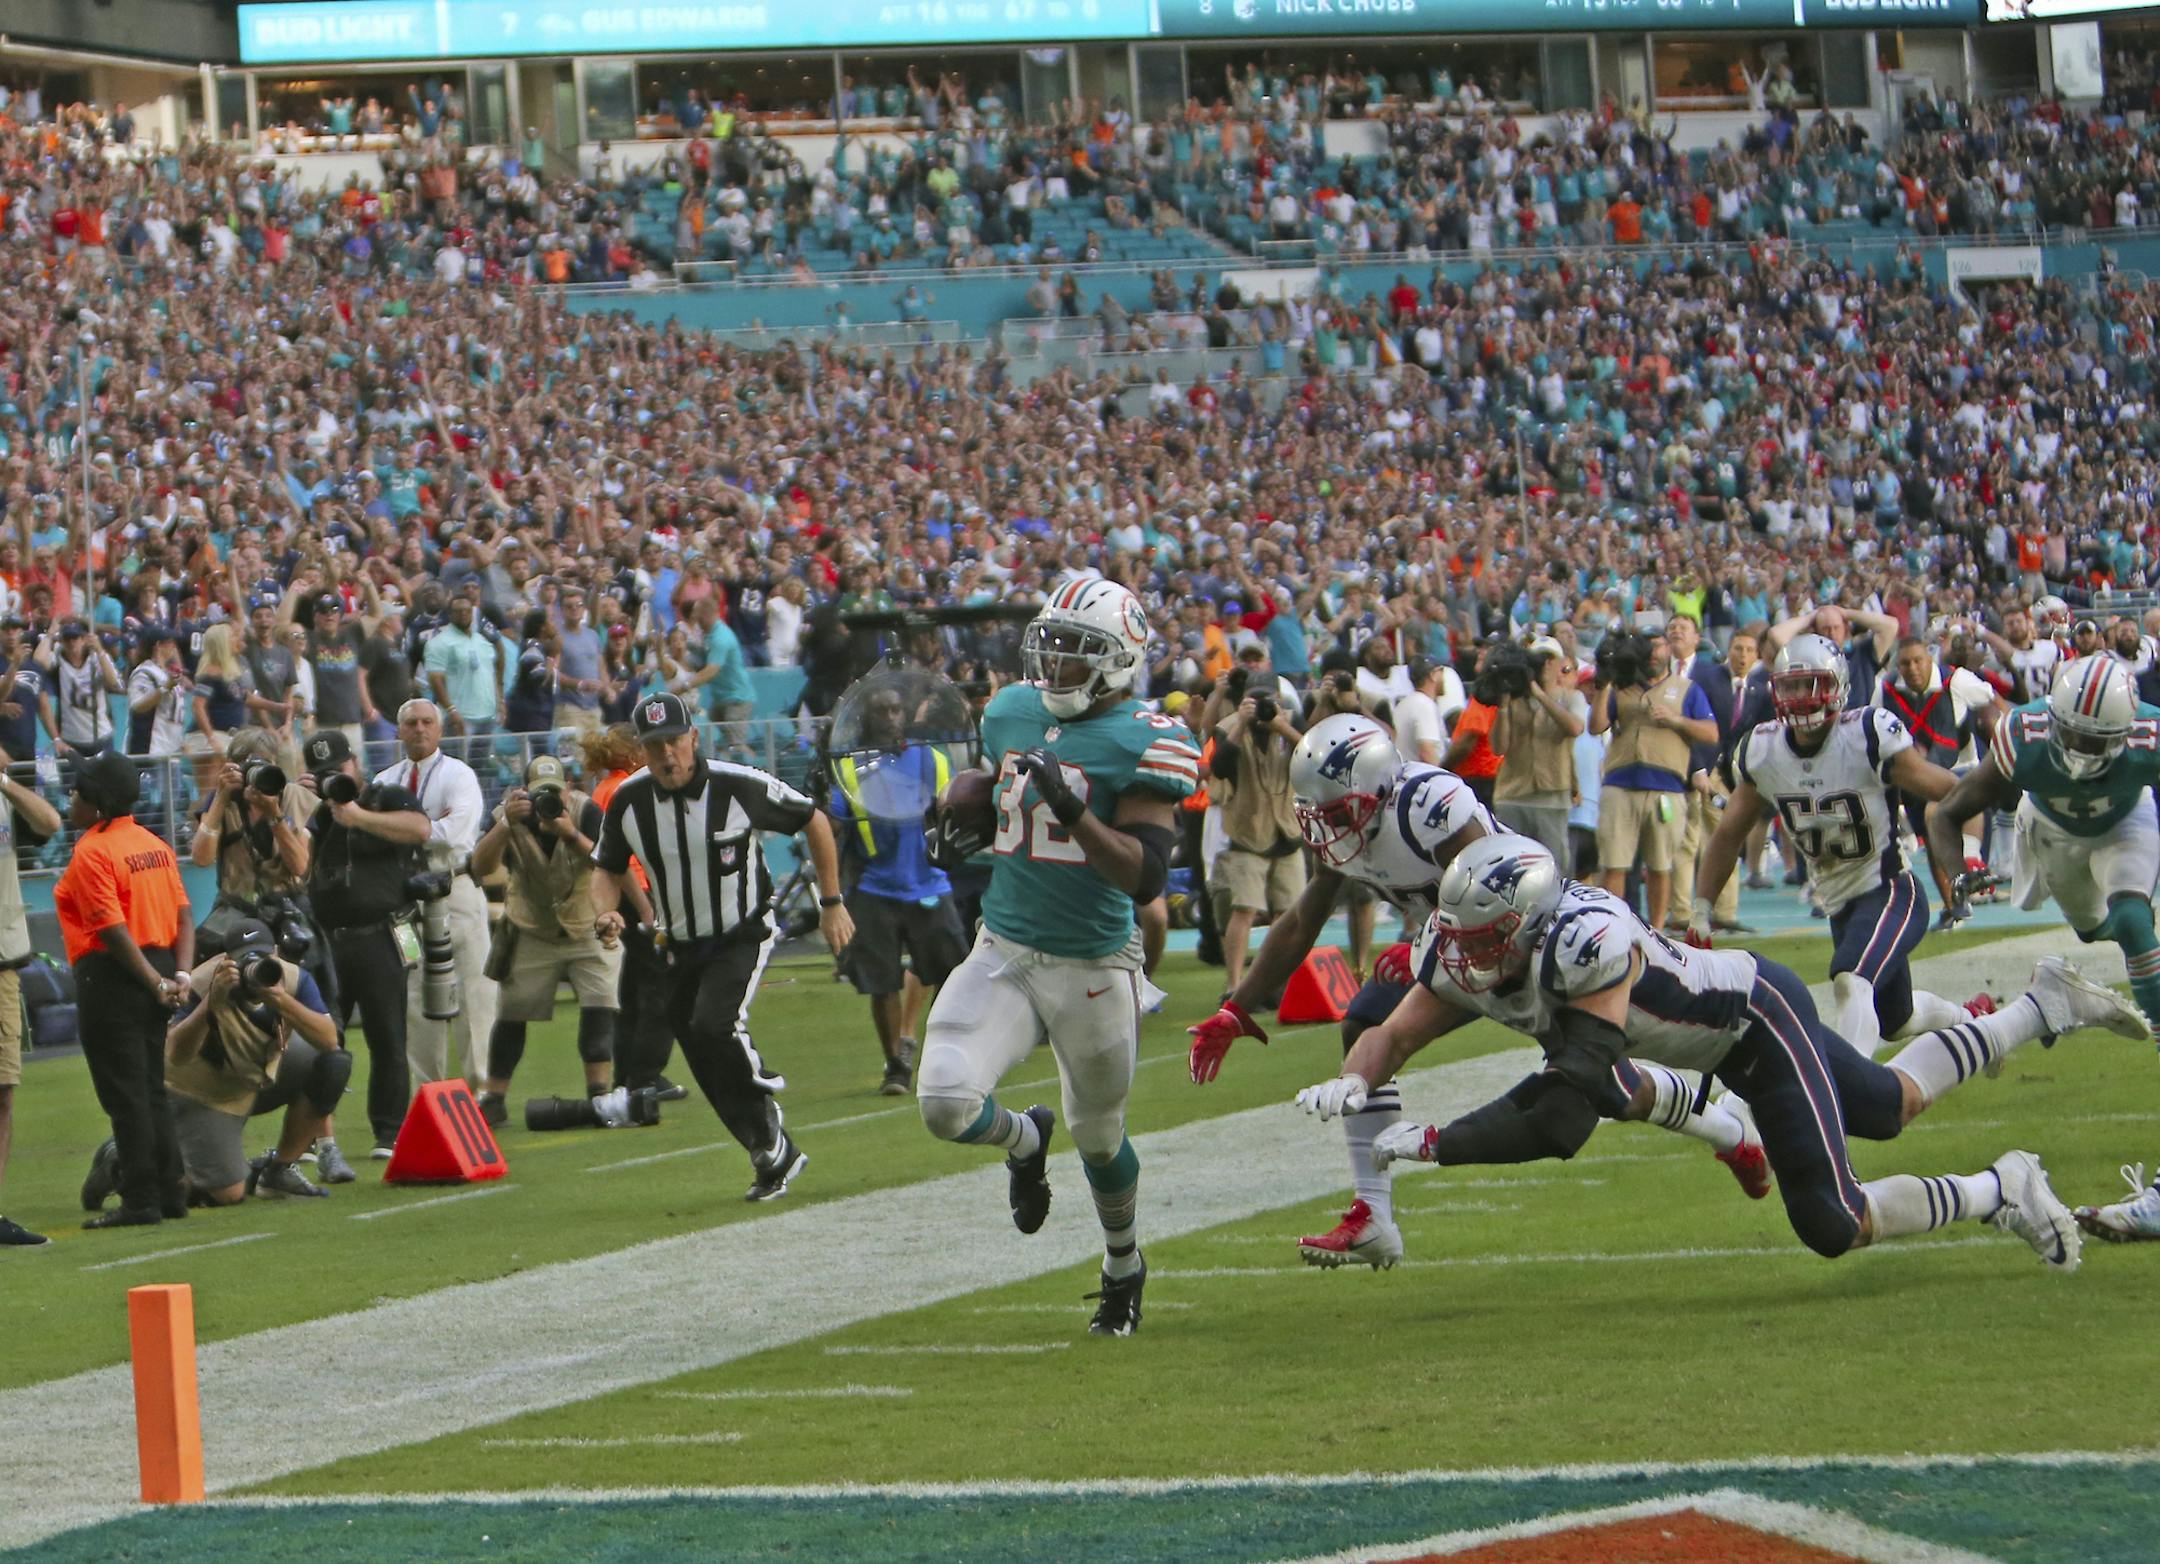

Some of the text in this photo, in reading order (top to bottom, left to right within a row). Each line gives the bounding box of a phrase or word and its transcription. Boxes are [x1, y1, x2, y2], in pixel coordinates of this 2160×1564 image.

[391, 471, 416, 490] 54
[992, 750, 1092, 865] 32
[1774, 788, 1876, 861] 53
[124, 849, 171, 875] SECURITY
[1313, 953, 1361, 1011] 20
[436, 1089, 499, 1167] 10
